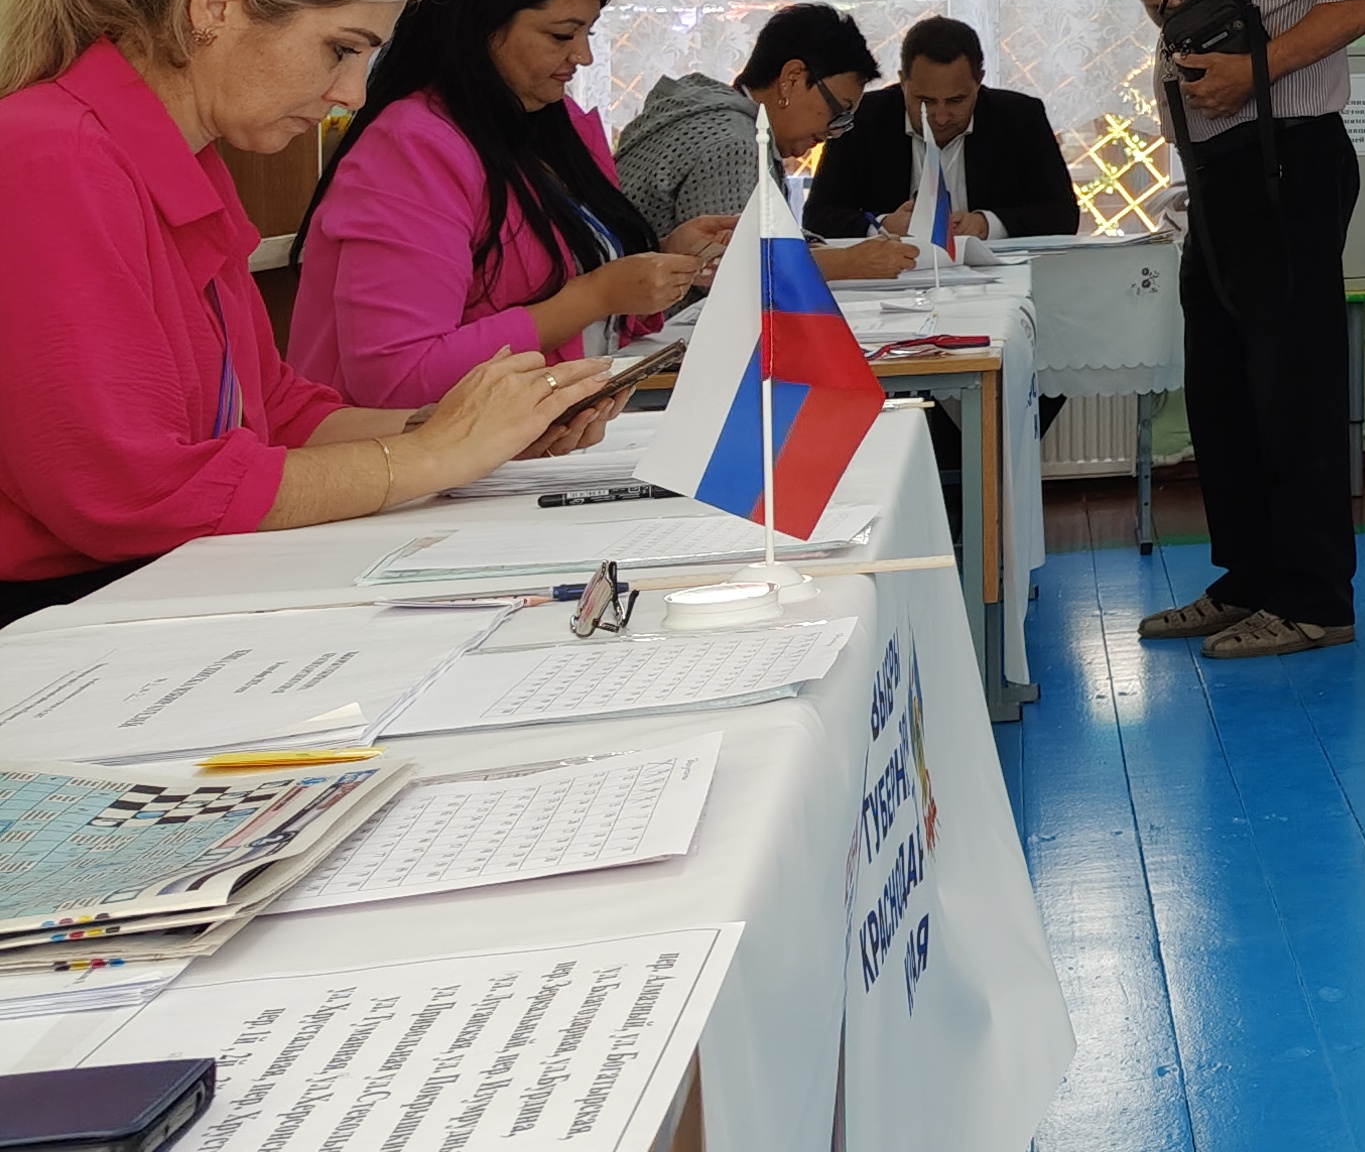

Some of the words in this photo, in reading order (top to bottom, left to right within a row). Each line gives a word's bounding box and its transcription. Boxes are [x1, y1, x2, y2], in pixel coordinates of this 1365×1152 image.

[541, 960, 578, 982] пер.
[592, 965, 623, 983] ул.
[646, 952, 680, 972] пер.
[326, 986, 357, 1003] ул.
[431, 984, 462, 1001] ул.
[488, 974, 519, 992] ул.
[370, 996, 401, 1013] ул.
[614, 973, 677, 1032] Алмазный,
[242, 1007, 286, 1030] пер.
[440, 993, 515, 1054] Луганская,
[495, 980, 573, 1054] Зеркальный,
[545, 982, 622, 1058] Благодарная,
[250, 1003, 351, 1082] Хрустальная,
[314, 1013, 396, 1075] Туманная,
[378, 1001, 458, 1072] Привольная
[608, 1033, 640, 1050] ул.
[432, 1054, 465, 1073] ул.
[478, 1053, 520, 1080] пер.
[229, 1082, 276, 1110] пер.
[500, 1057, 572, 1138] ул.Бурдина,
[557, 1051, 640, 1141] Богатырская,
[197, 1110, 263, 1152] Хруст
